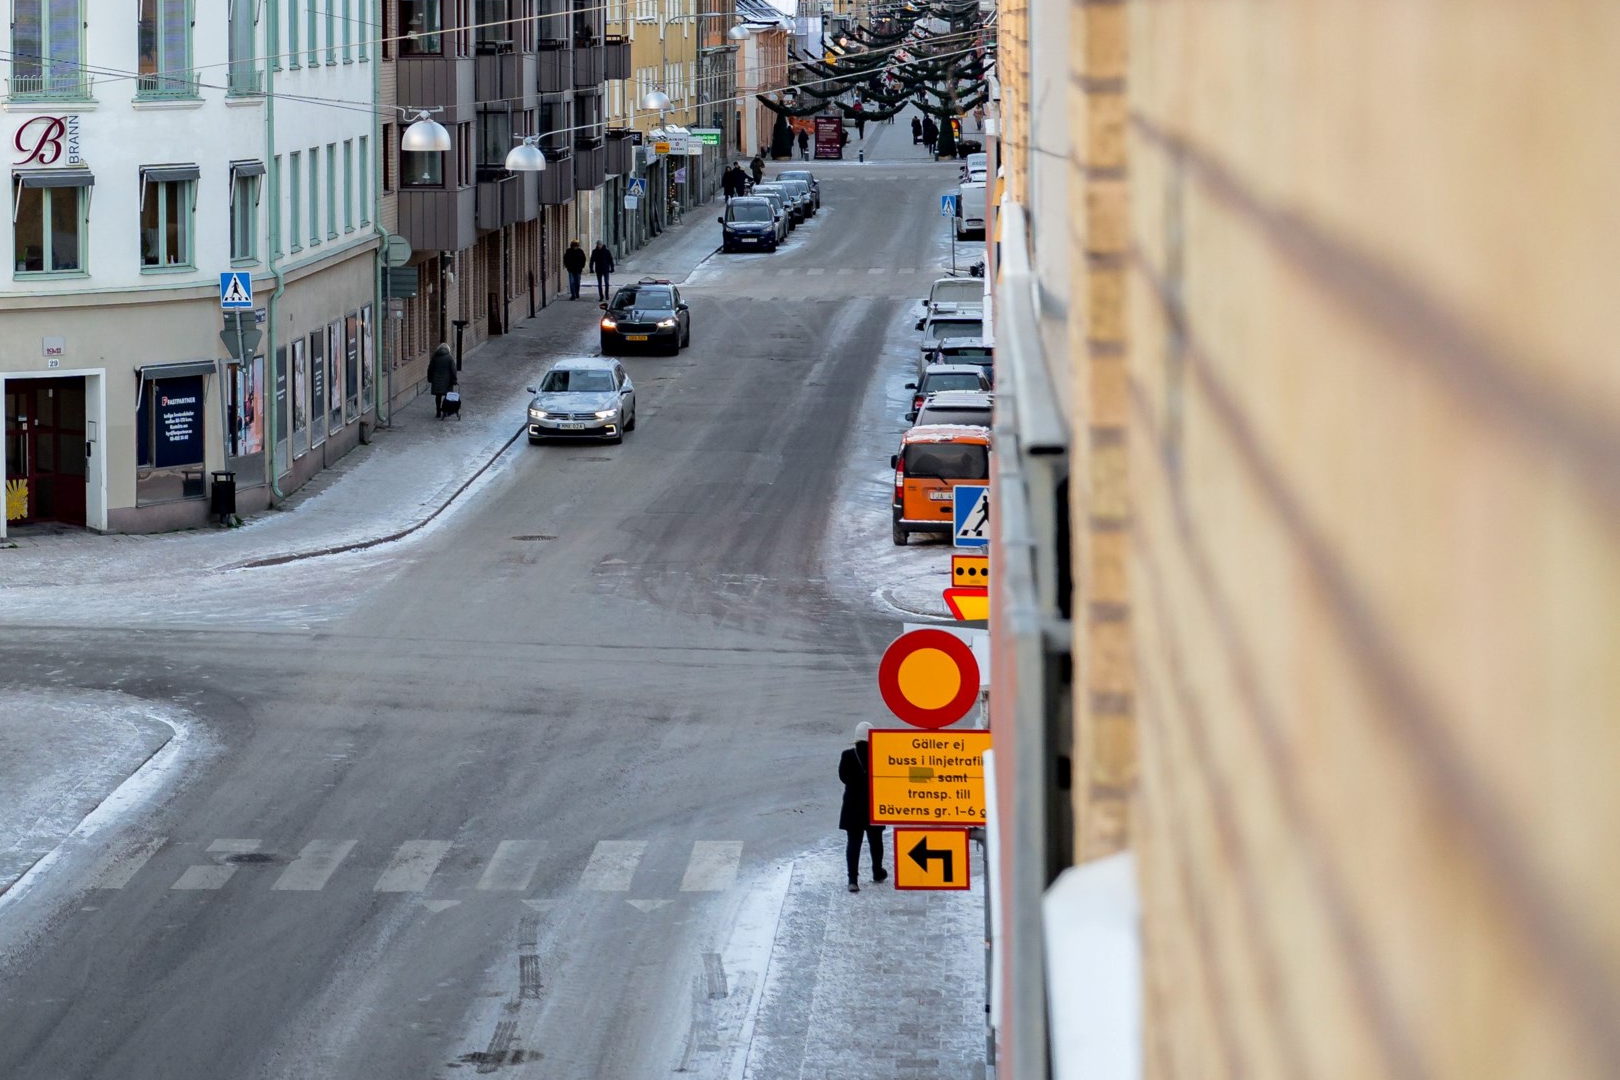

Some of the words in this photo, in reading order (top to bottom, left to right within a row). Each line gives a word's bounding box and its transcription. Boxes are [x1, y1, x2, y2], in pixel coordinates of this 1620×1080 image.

[13, 116, 68, 165] B
[68, 115, 79, 164] BRANN
[912, 739, 949, 750] Gäller
[953, 739, 965, 751] ej
[888, 756, 917, 766] buss
[921, 756, 925, 766] i
[938, 773, 968, 783] samt
[908, 789, 952, 801] transp.
[956, 789, 971, 800] till
[879, 804, 930, 816] Bäverns
[934, 808, 951, 818] gr.
